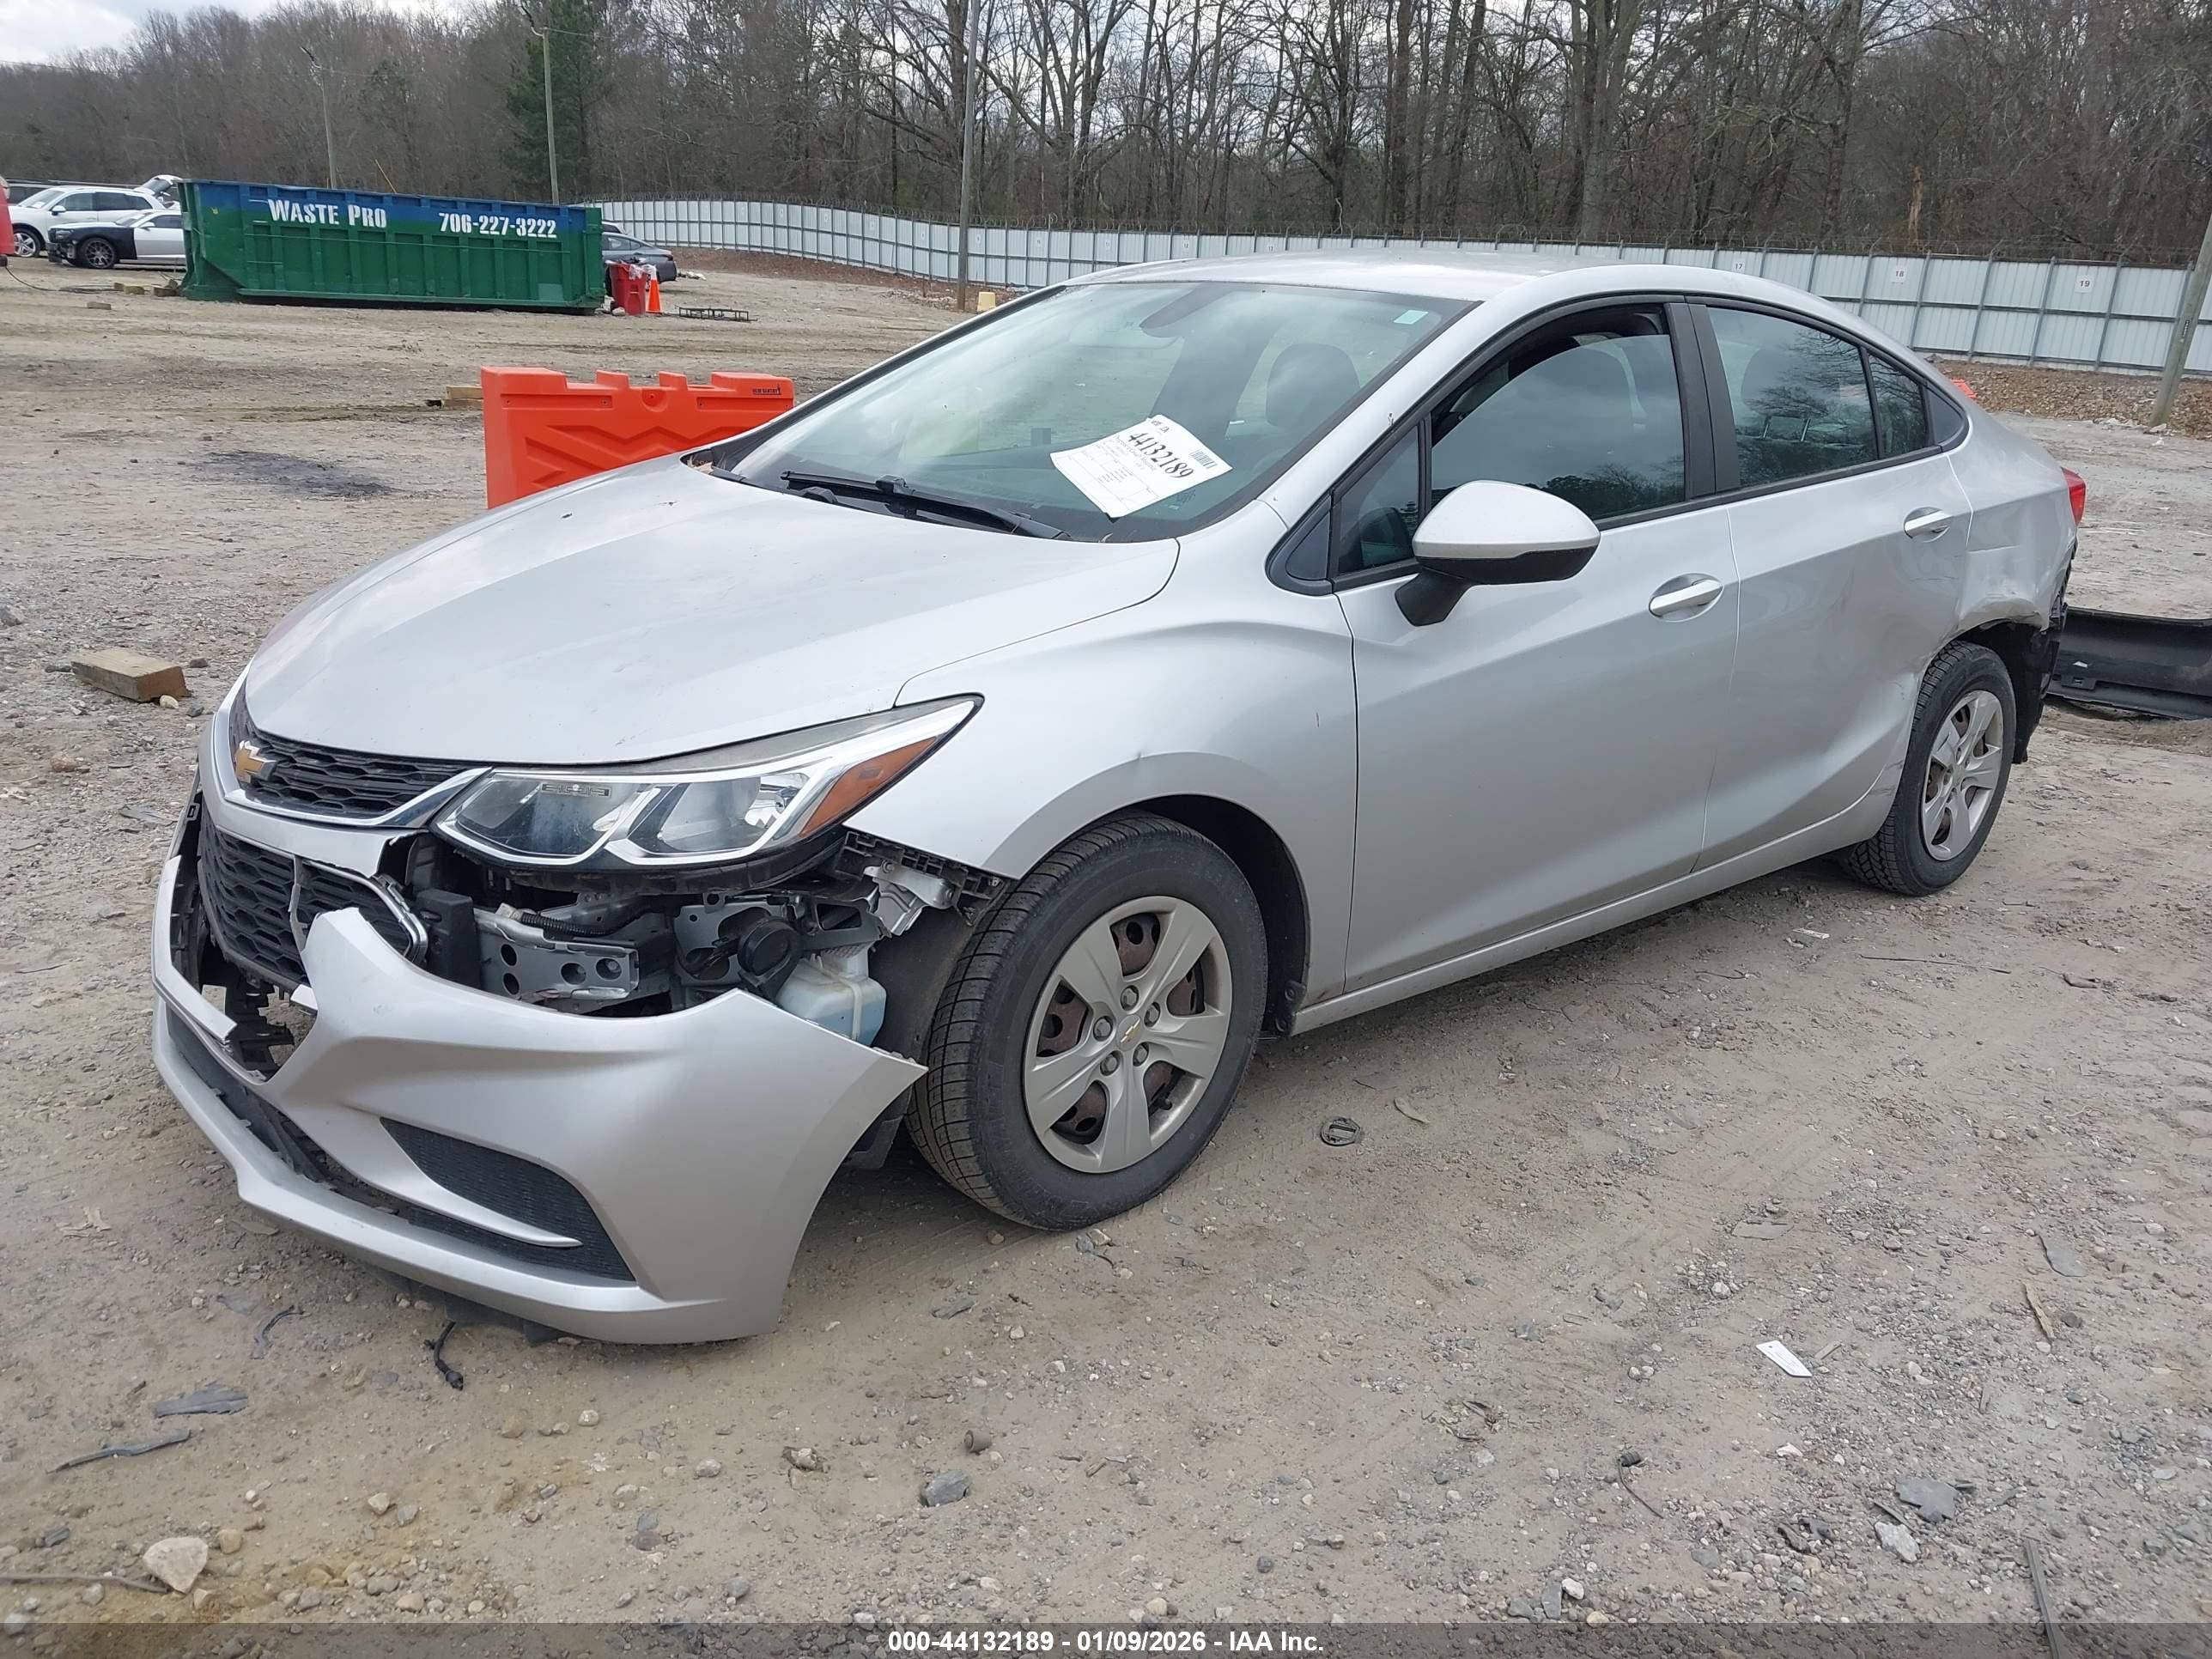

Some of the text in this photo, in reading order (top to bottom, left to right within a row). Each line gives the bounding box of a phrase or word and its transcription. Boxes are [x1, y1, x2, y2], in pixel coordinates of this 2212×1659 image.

[268, 199, 556, 239] WASTE PRO 706-227-3222
[1128, 433, 1194, 478] 44132189
